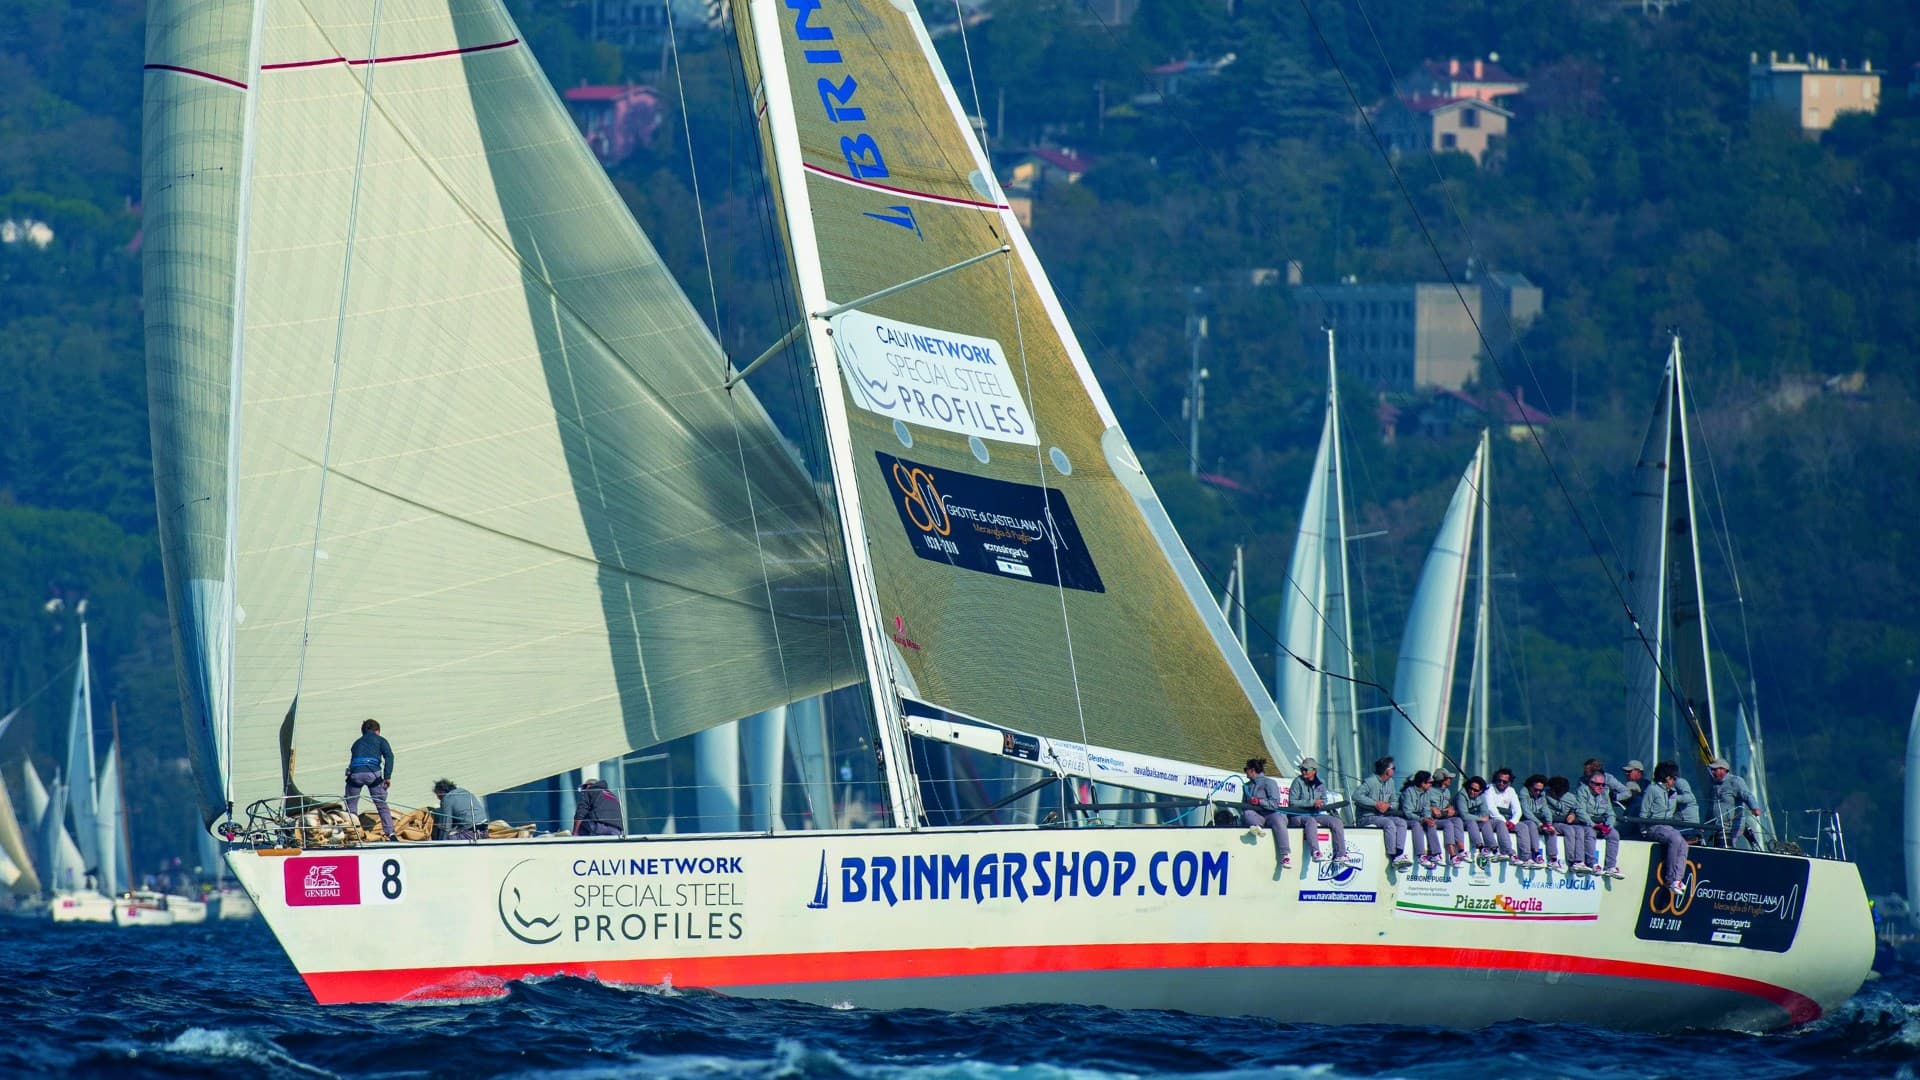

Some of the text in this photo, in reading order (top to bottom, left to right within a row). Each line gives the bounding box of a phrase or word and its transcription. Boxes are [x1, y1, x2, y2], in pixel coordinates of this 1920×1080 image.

[886, 352, 1012, 399] SPECIAL STEEL
[897, 385, 1025, 436] PROFILES
[946, 503, 978, 521] GROTTE
[986, 512, 1039, 532] CASTELLANA
[304, 888, 341, 898] GENERALI
[381, 858, 402, 900] 8
[840, 850, 1229, 908] BRINMARSHOP.COM
[574, 883, 744, 908] SPECIAL STEEL
[1455, 895, 1542, 912] Piazza Puglia
[1696, 888, 1725, 900] GROTTE
[1733, 891, 1778, 905] CASTELLANA
[574, 912, 743, 942] PROFILES
